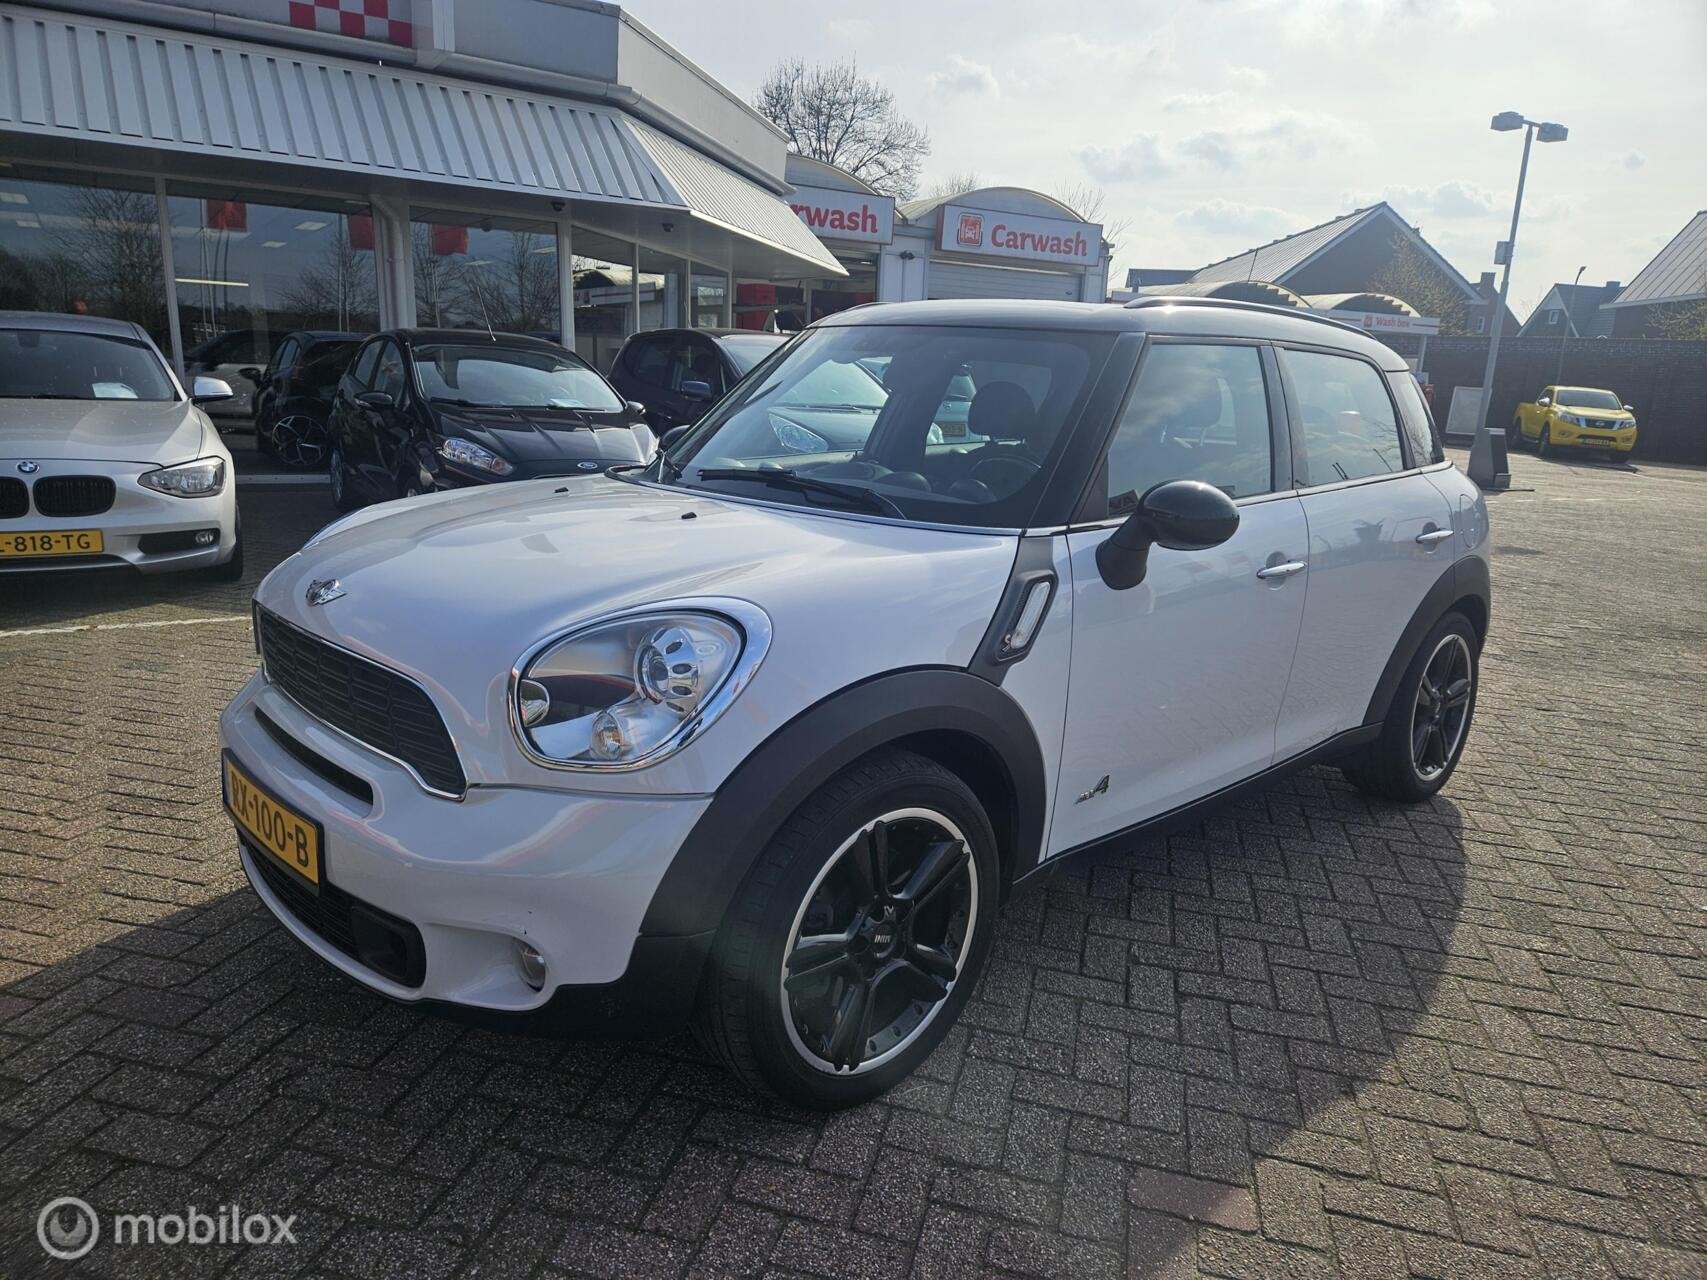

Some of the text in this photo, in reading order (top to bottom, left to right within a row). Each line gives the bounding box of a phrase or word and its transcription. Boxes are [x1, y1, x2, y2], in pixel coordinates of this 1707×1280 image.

[991, 223, 1087, 257] Carwash
[0, 533, 90, 553] -818-TG
[231, 770, 309, 868] RX-100-B
